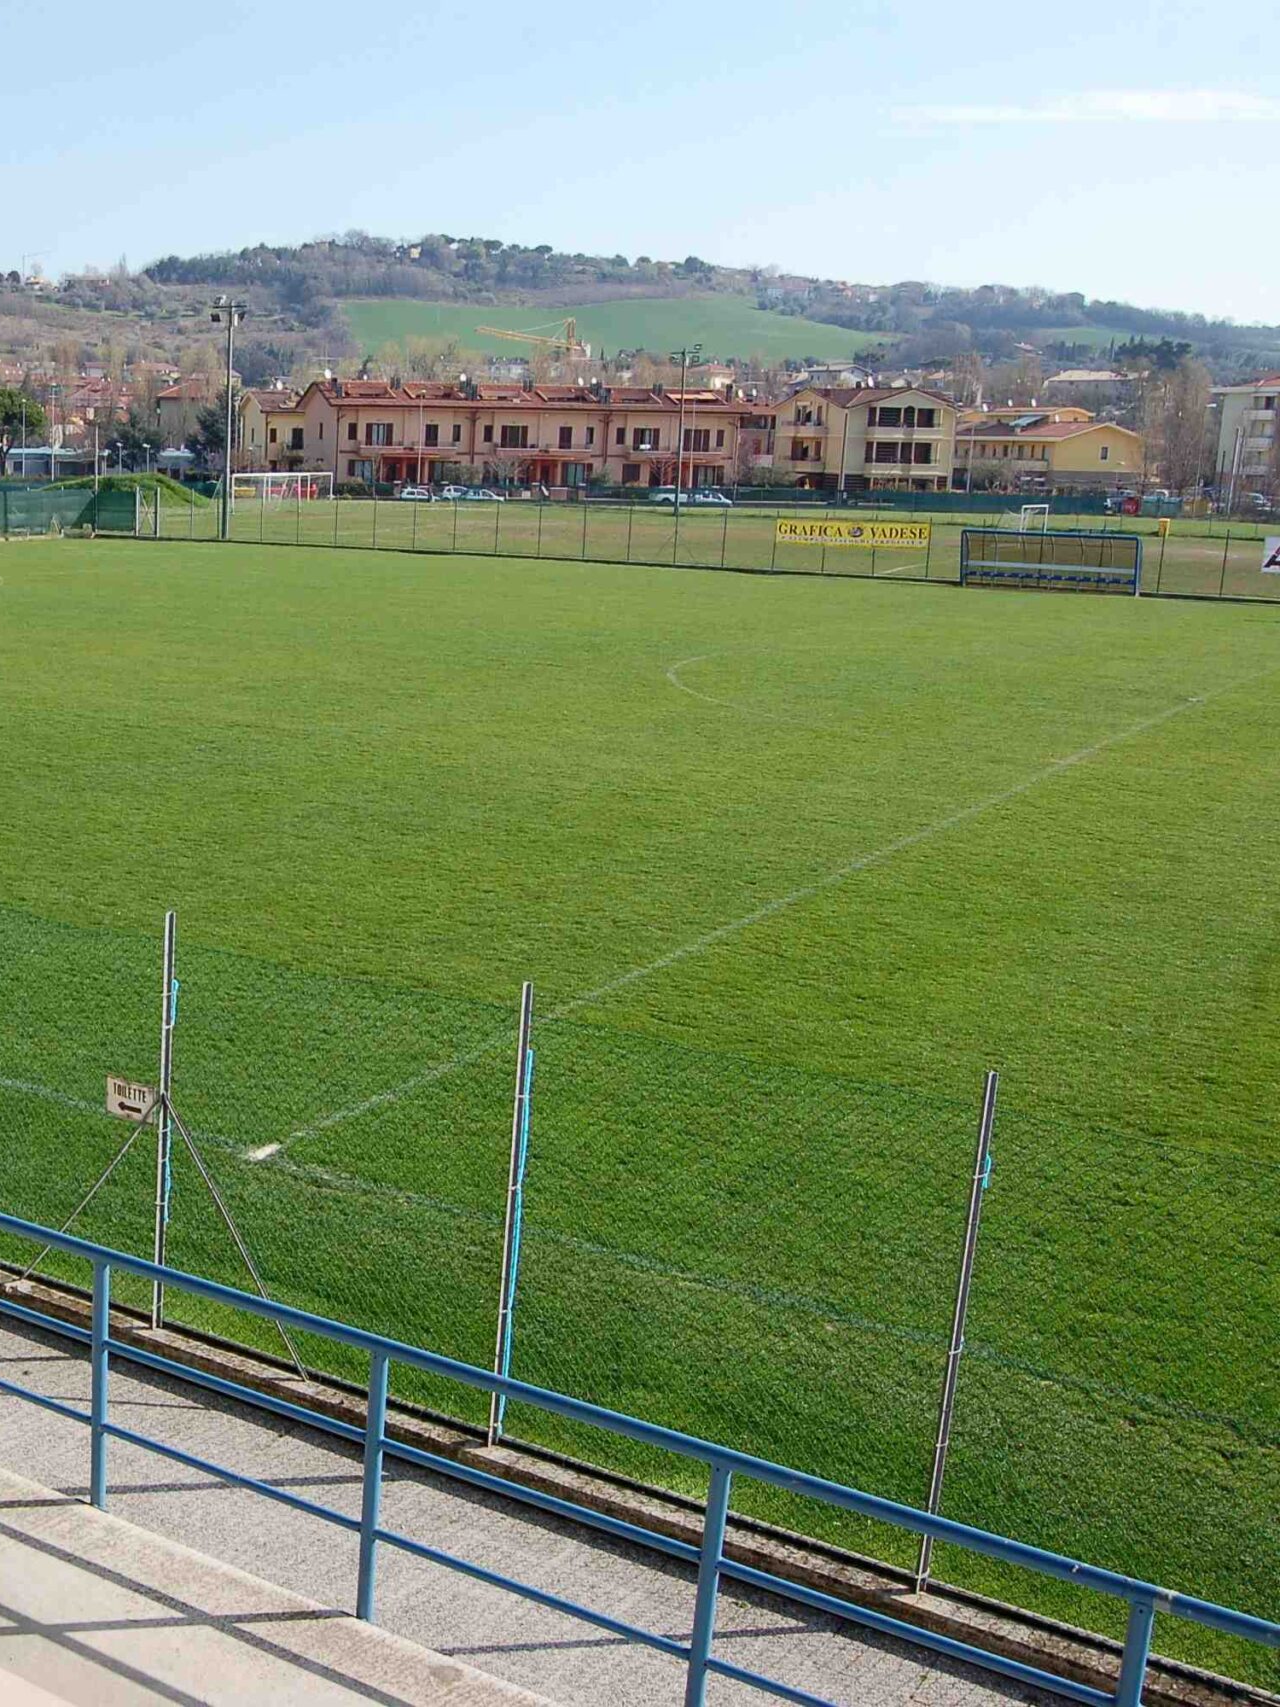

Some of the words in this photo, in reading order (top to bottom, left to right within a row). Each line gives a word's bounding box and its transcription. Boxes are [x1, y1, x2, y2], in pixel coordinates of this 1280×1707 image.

[778, 522, 843, 538] GRAFICA
[870, 527, 927, 540] VADESE
[113, 1082, 146, 1103] TOILETTE
